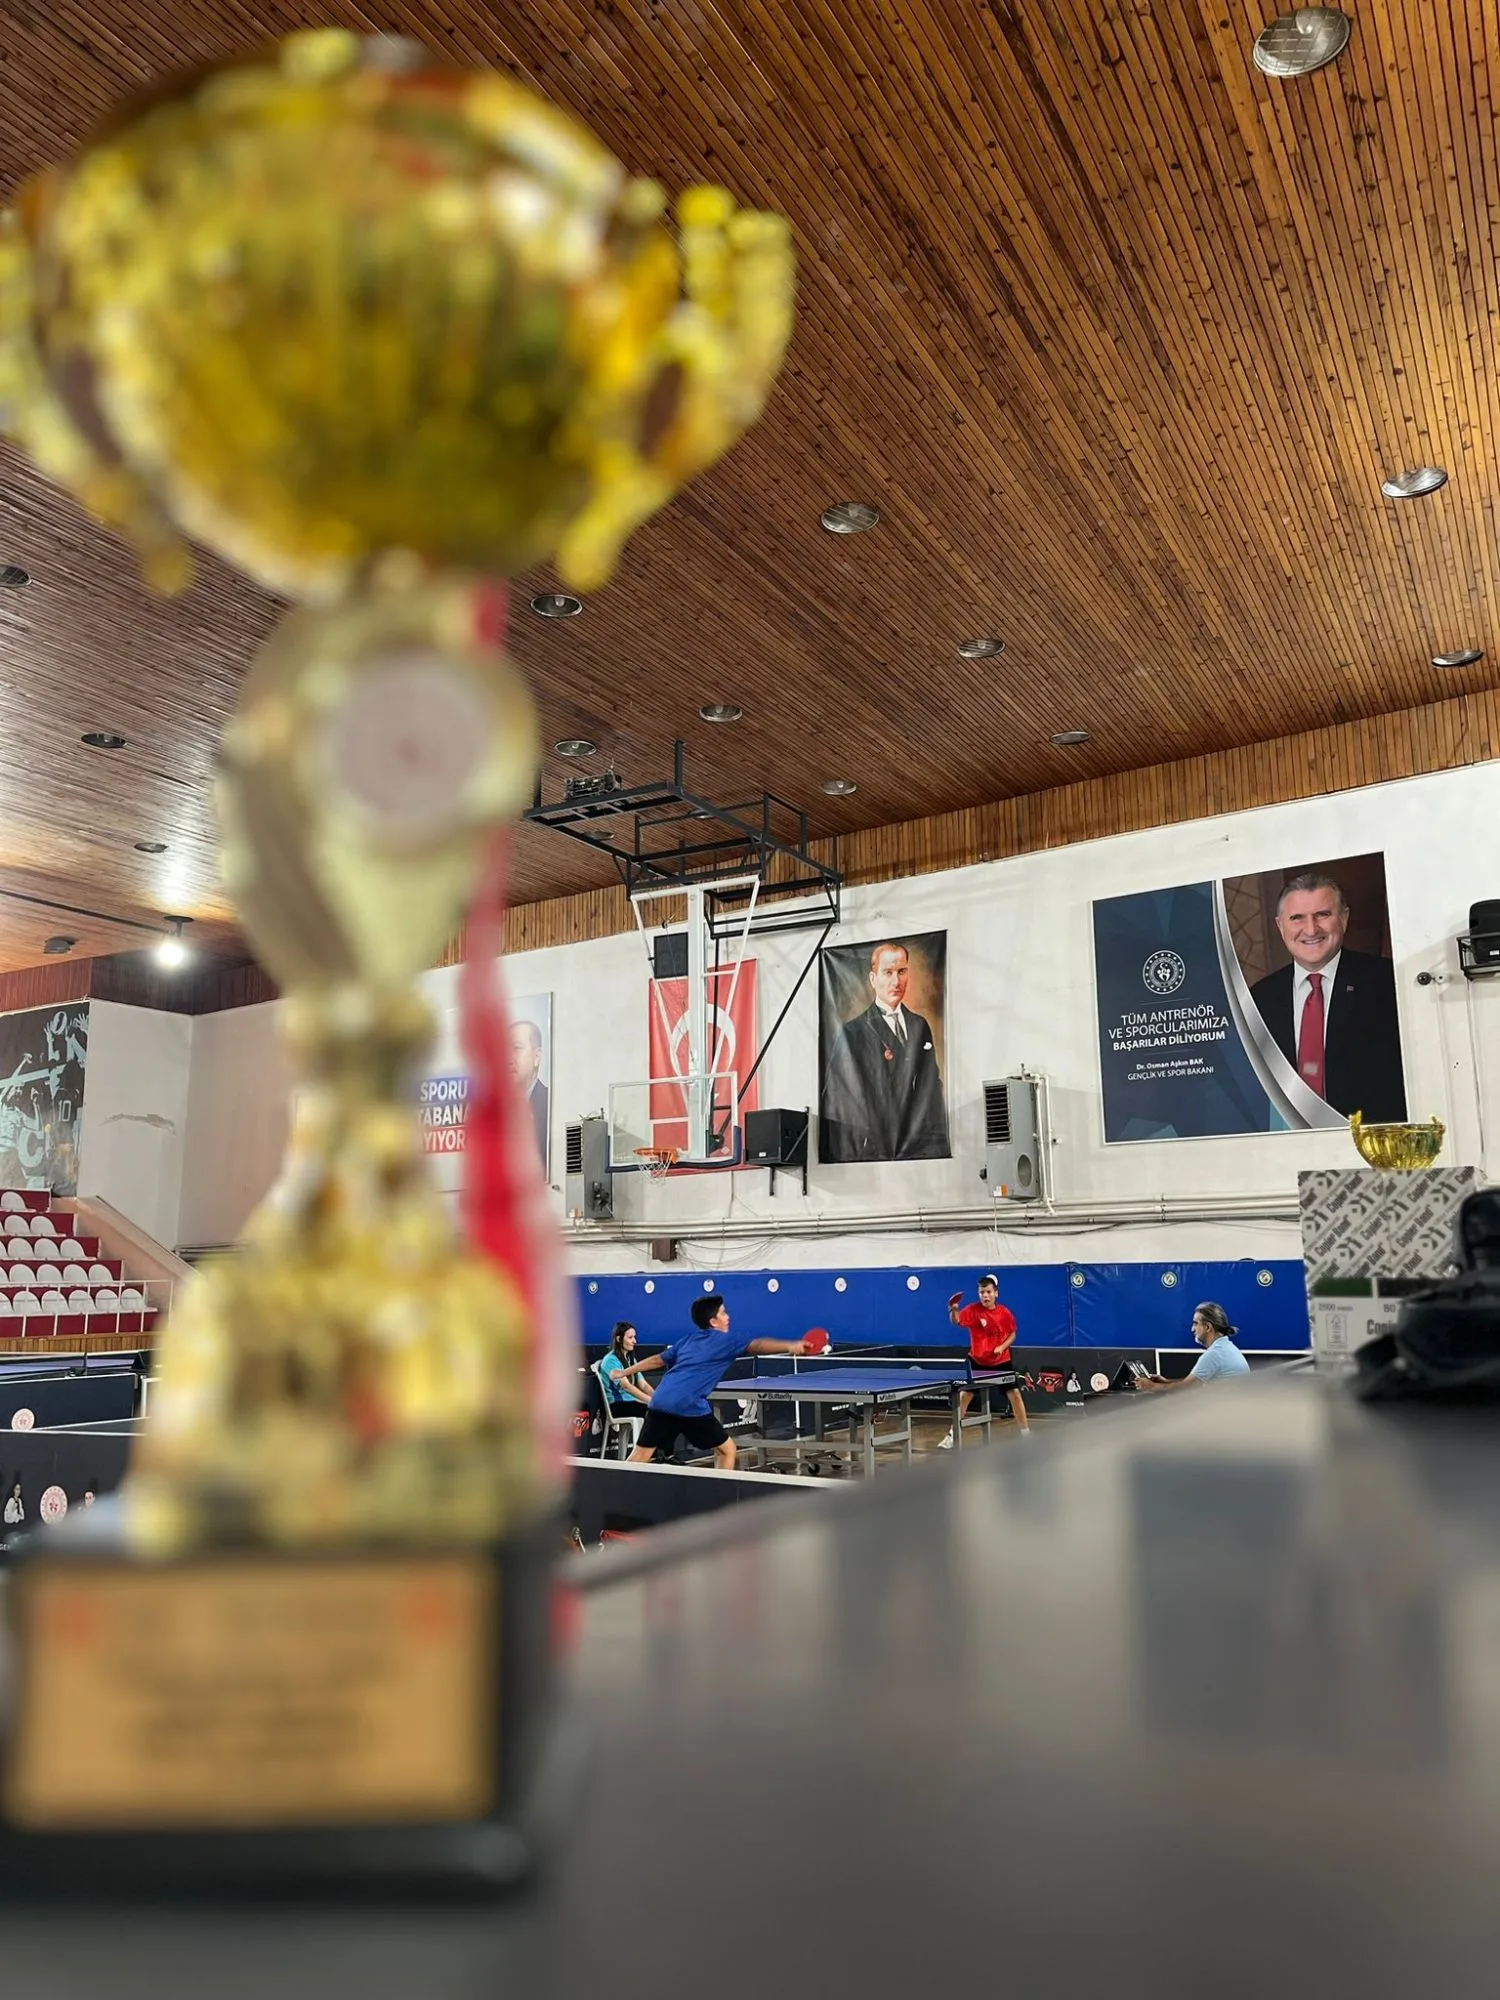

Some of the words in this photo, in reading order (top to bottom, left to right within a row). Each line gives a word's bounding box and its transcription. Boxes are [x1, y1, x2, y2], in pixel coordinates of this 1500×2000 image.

[1121, 1012, 1147, 1026] TÜM
[1150, 1004, 1215, 1023] ANTRENÖR
[1108, 1028, 1123, 1039] VE
[1125, 1016, 1229, 1038] SPORCULARIMIZA
[1113, 1037, 1167, 1051] BAŞARILAR
[1169, 1031, 1226, 1045] DİLİYORUM
[1157, 1070, 1167, 1078] VE
[1168, 1068, 1186, 1077] SPOR
[1187, 1066, 1214, 1076] BAKANI
[420, 1080, 468, 1101] SPORU
